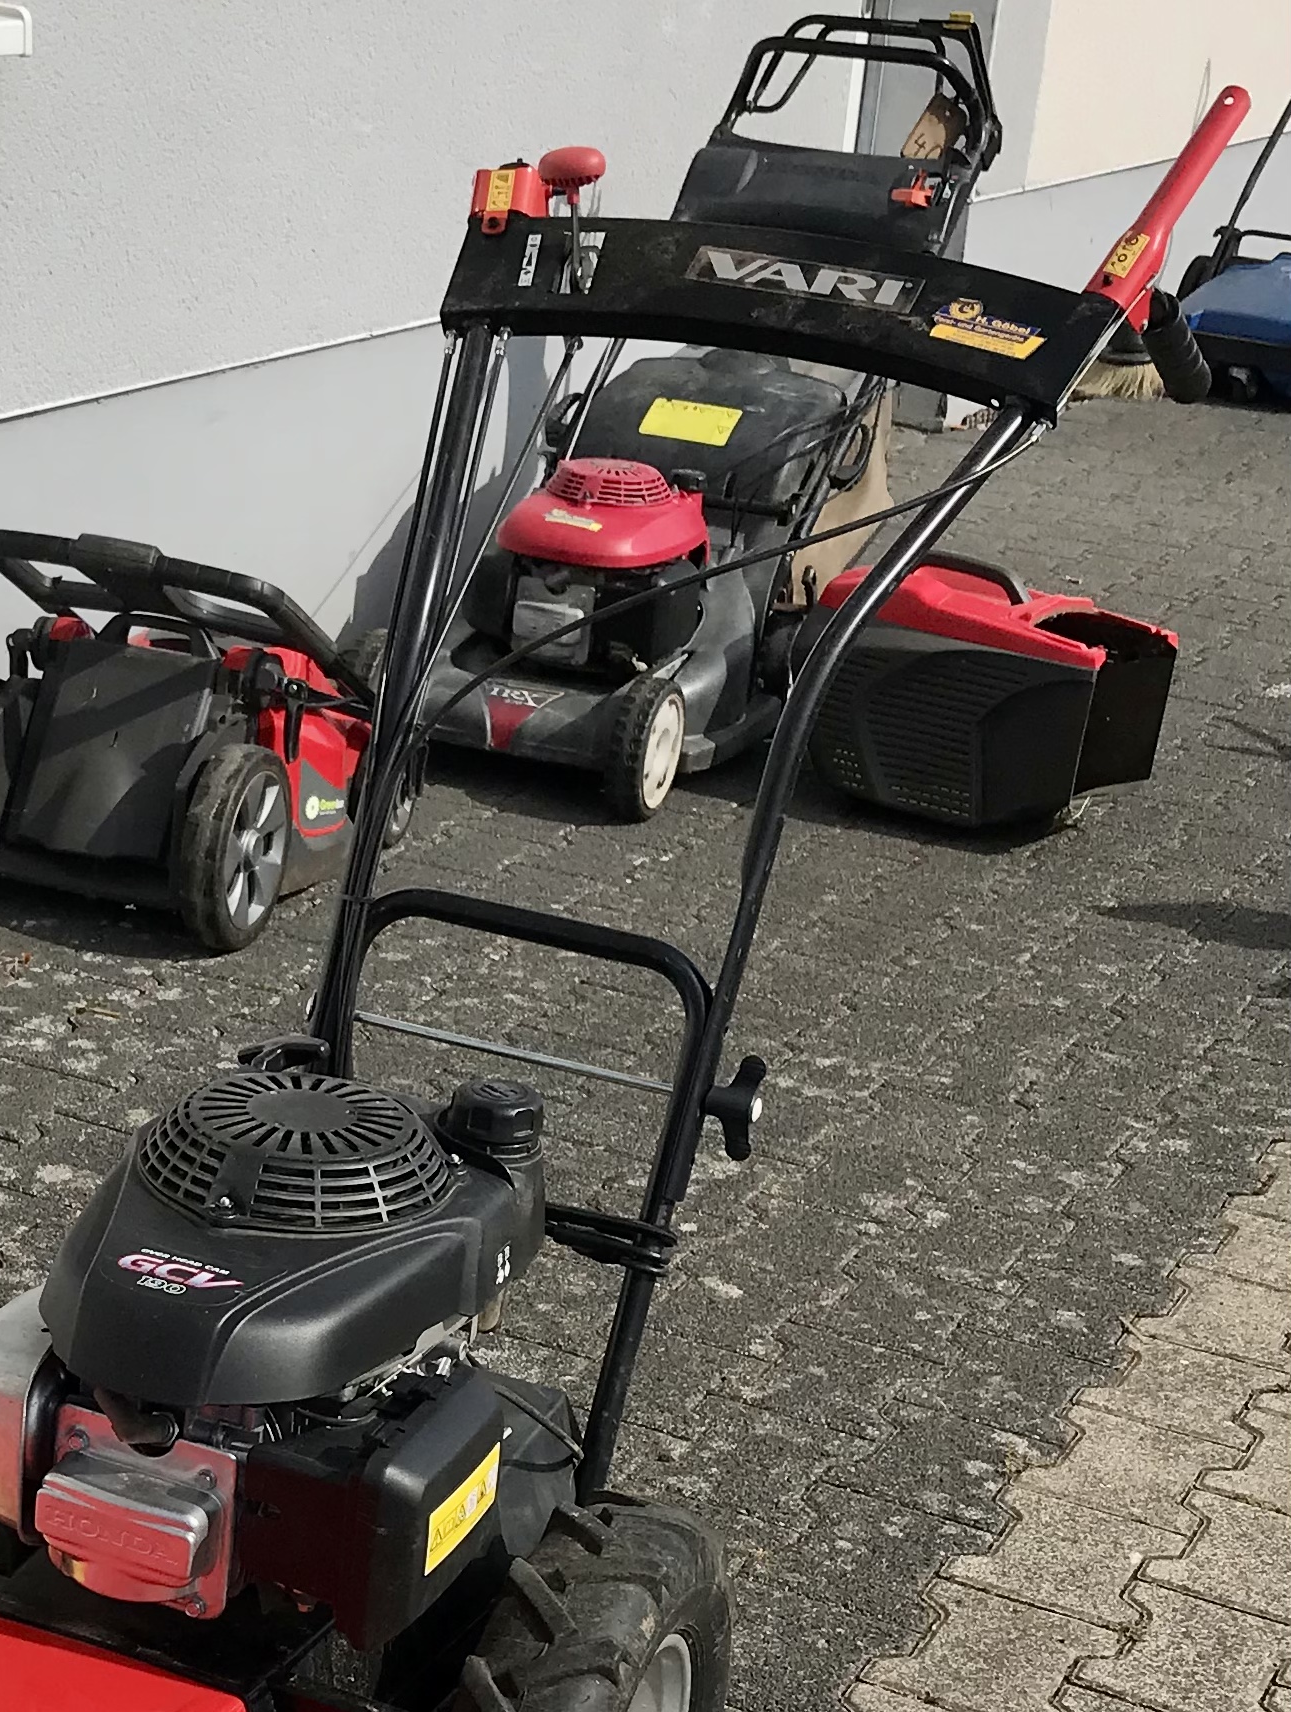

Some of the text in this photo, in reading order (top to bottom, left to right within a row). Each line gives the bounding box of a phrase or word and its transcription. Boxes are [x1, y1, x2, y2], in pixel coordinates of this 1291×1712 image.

[707, 251, 905, 306] VARI
[117, 1254, 244, 1288] GCV
[44, 1504, 179, 1567] HONDA
